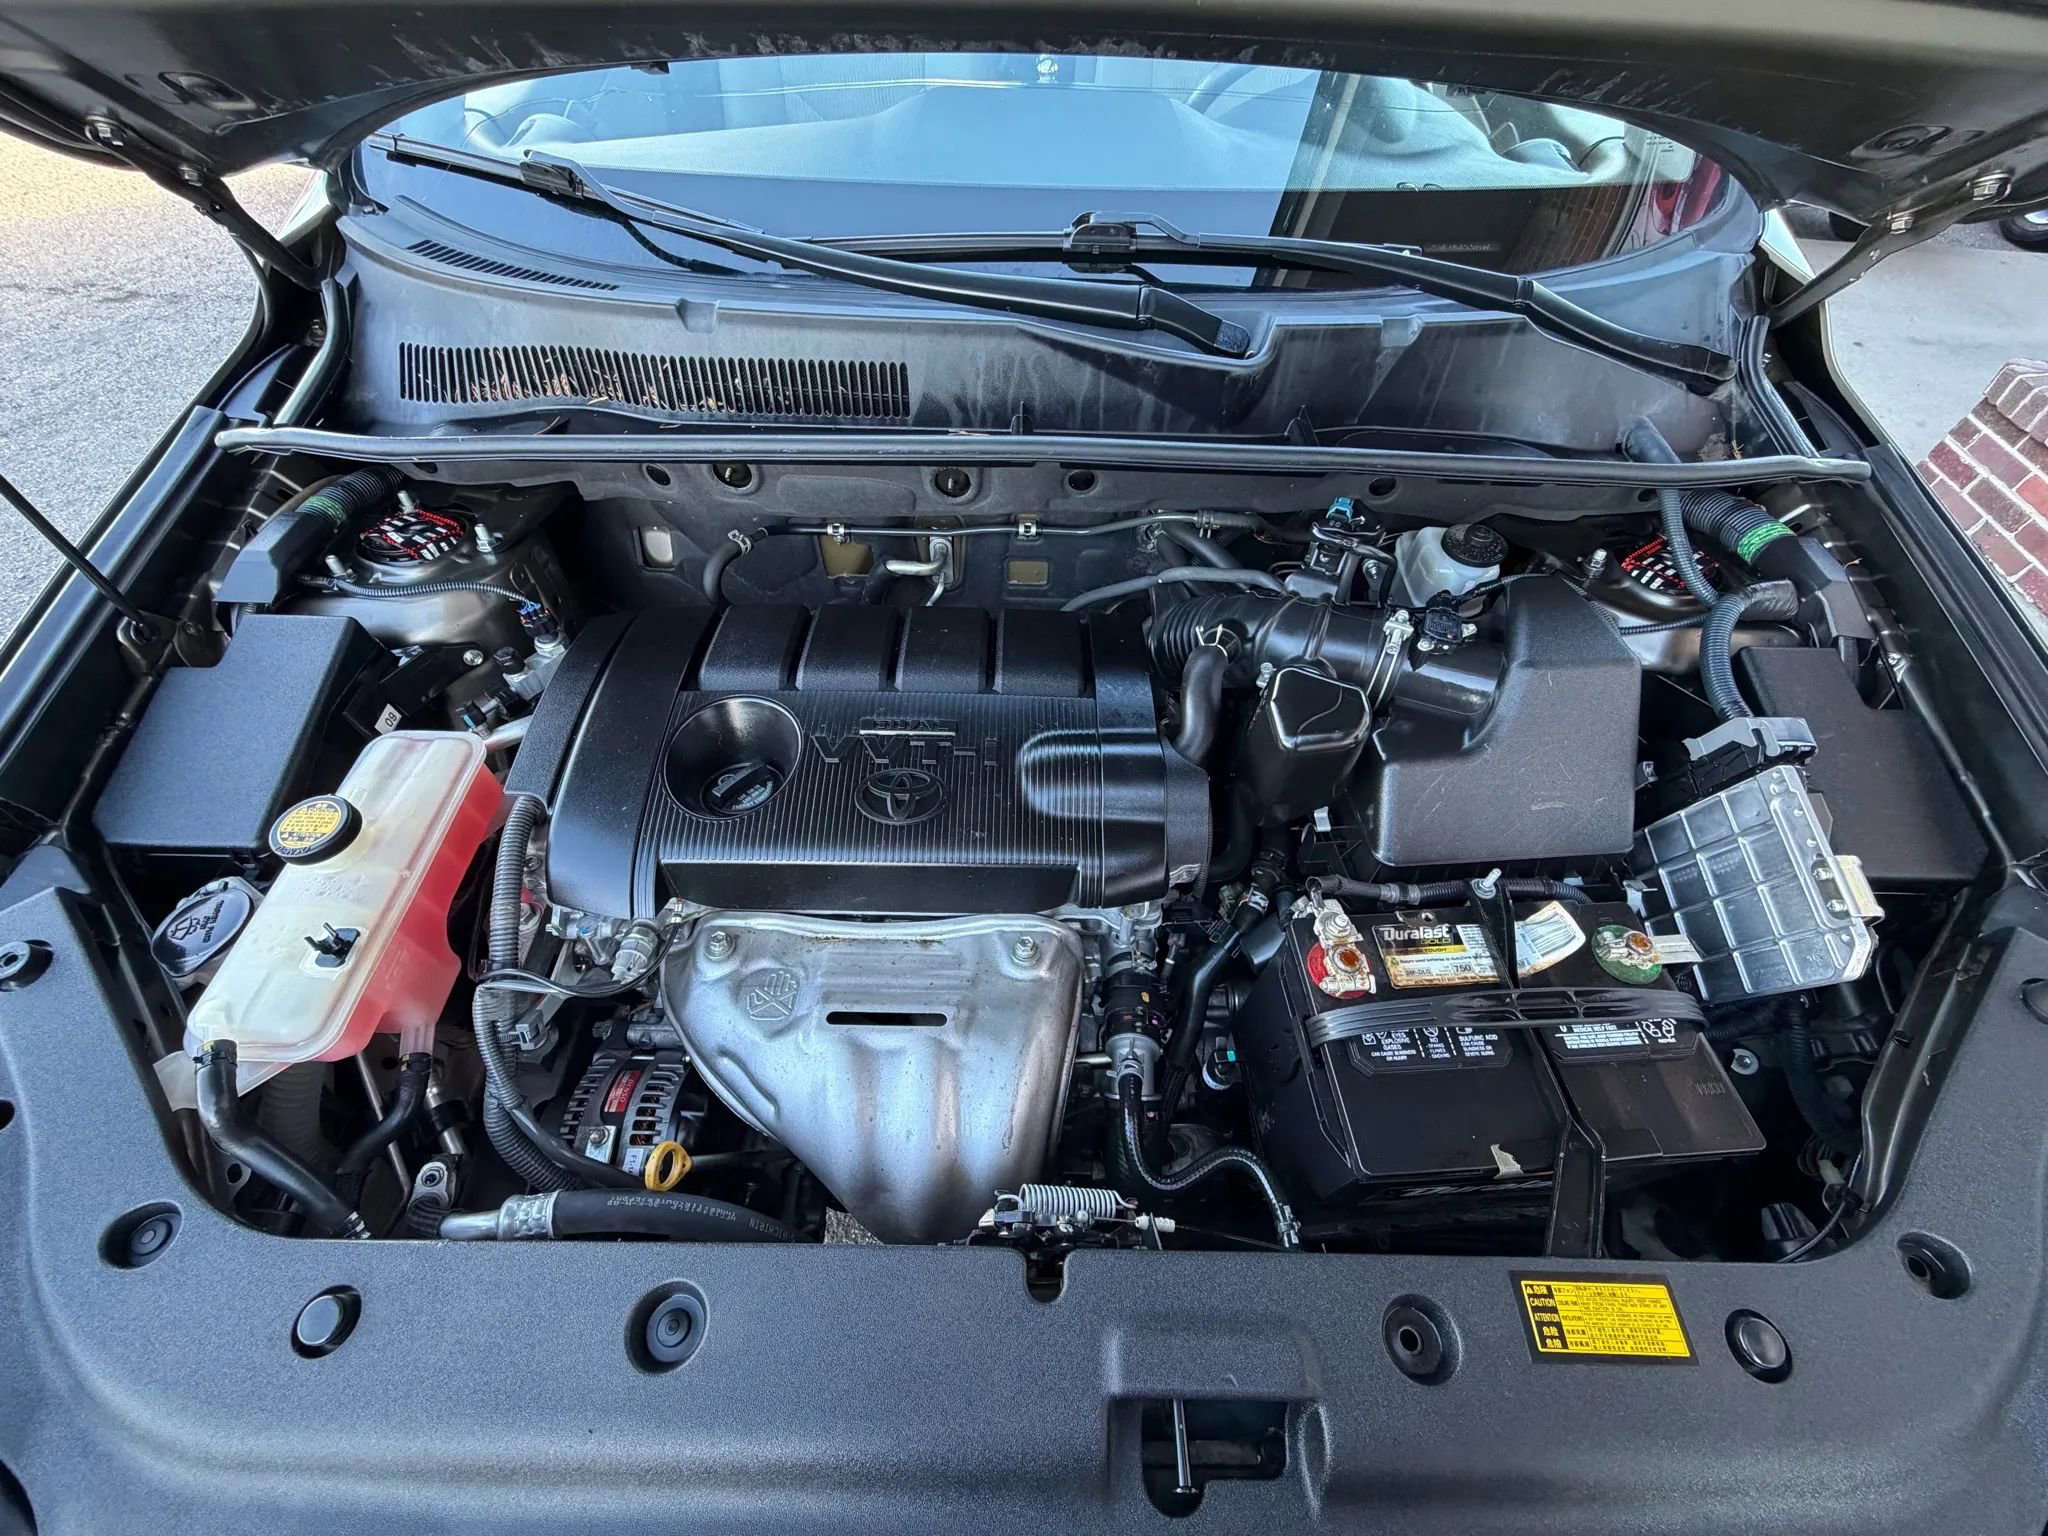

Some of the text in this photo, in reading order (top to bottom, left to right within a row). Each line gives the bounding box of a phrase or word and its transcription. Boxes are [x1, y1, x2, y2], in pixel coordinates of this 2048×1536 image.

[1379, 923, 1450, 941] Duralast
[1420, 937, 1452, 945] GOLD
[1453, 964, 1472, 973] 750
[619, 1079, 635, 1103] DENSO
[1529, 1297, 1557, 1307] CAUTION
[1534, 1312, 1561, 1322] ATTENTION
